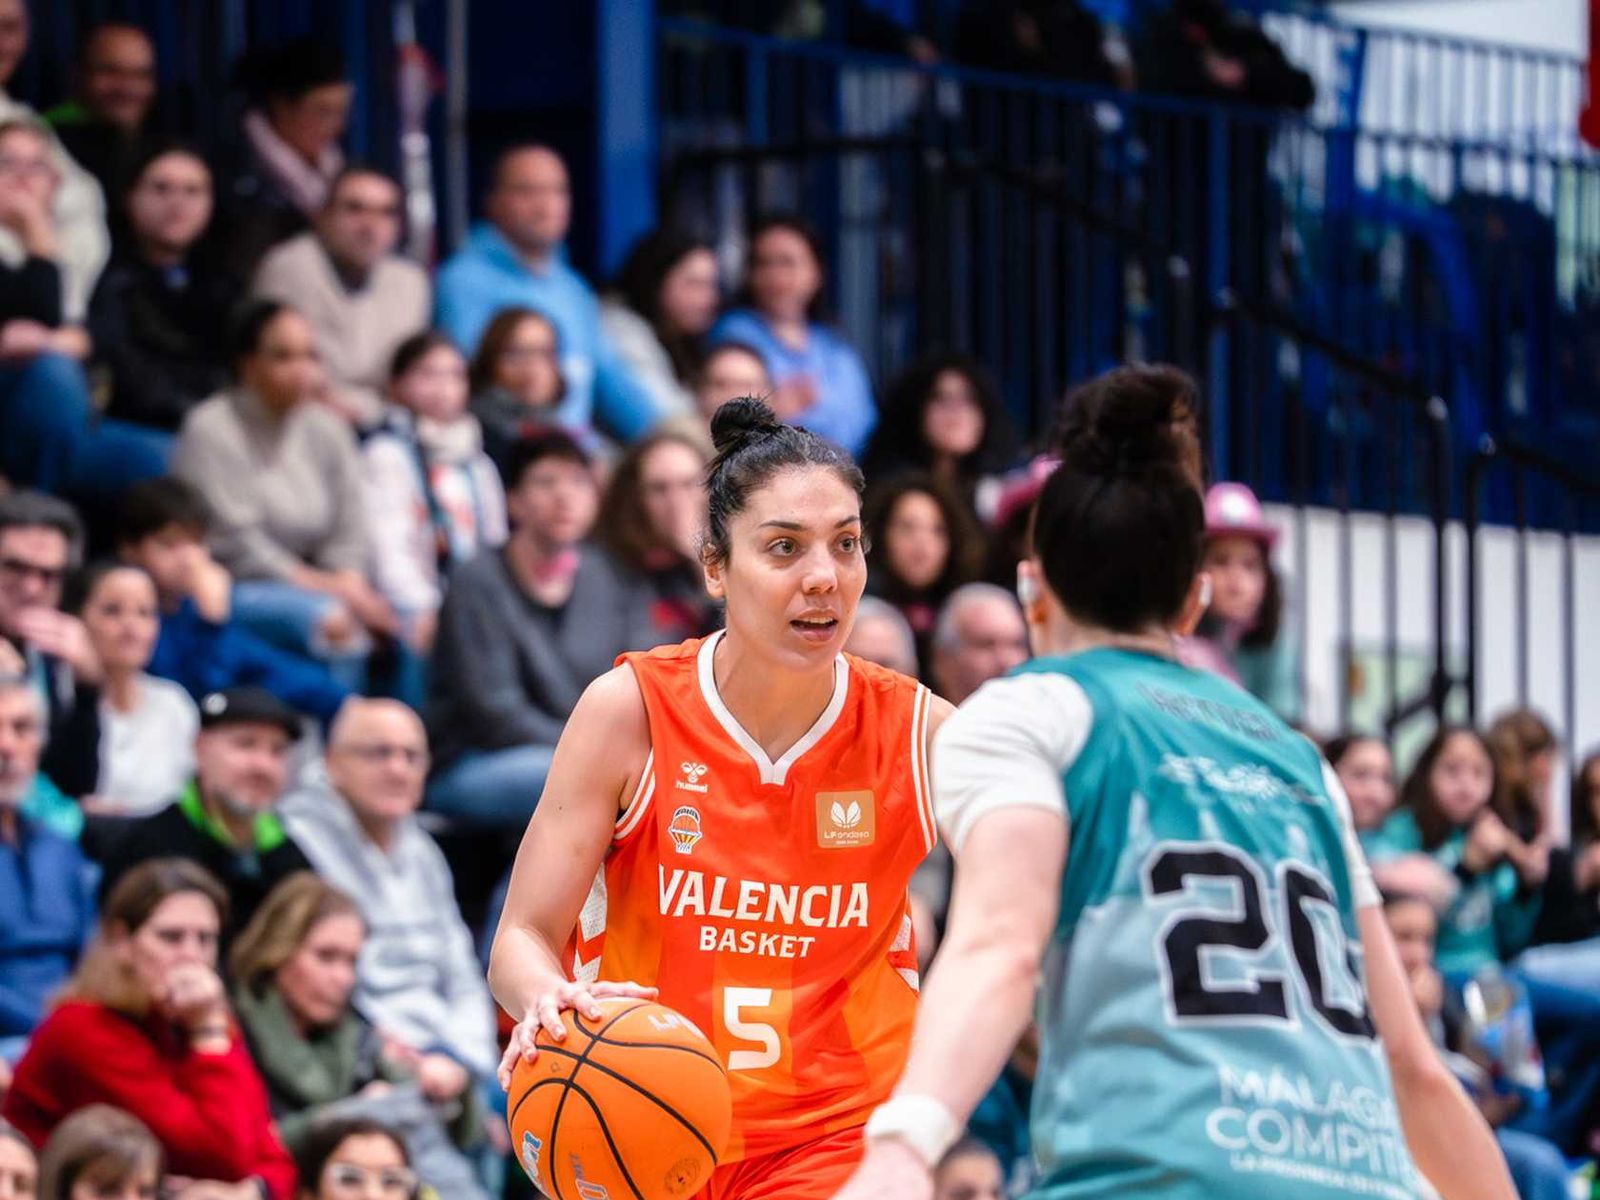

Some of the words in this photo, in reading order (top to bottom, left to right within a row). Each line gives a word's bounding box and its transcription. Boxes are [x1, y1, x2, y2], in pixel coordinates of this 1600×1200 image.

[658, 863, 869, 929] VALENCIA
[699, 925, 816, 959] BASKET
[1141, 840, 1382, 1043] 20
[723, 986, 782, 1072] 5
